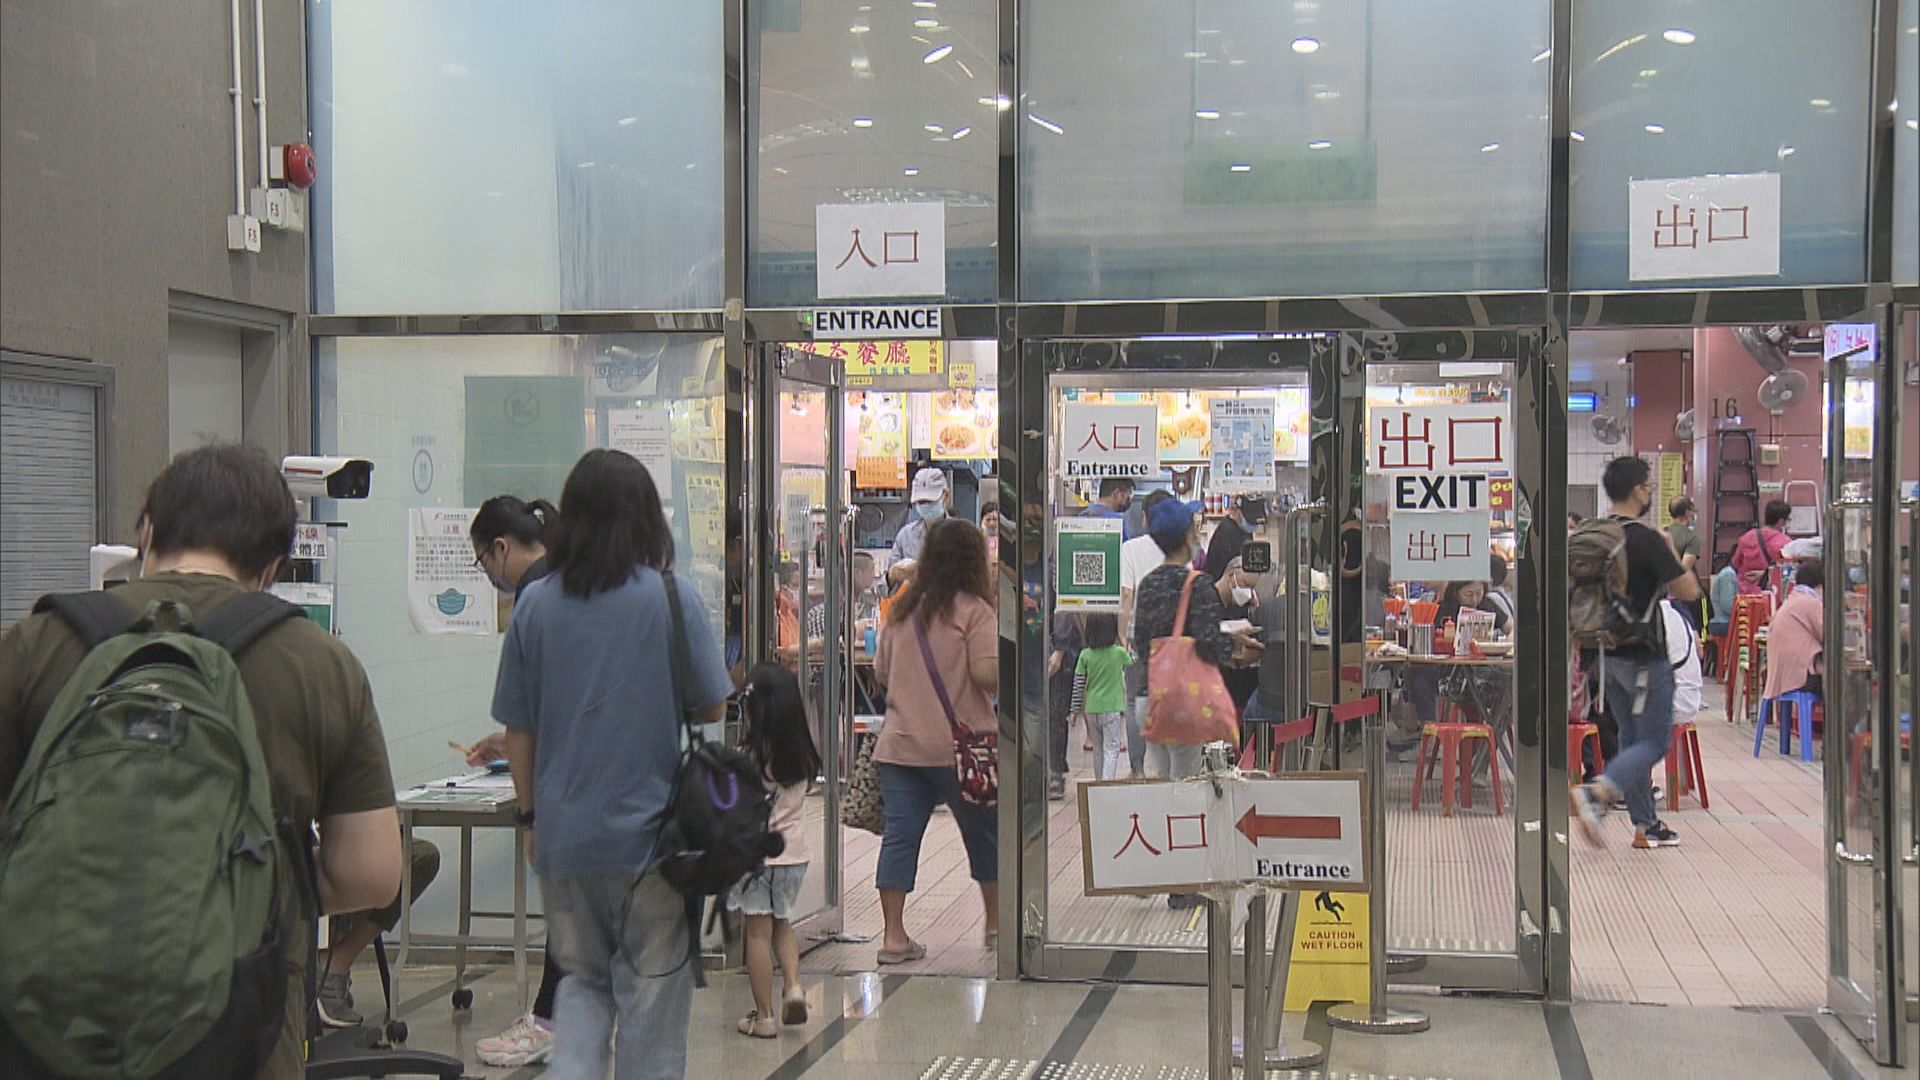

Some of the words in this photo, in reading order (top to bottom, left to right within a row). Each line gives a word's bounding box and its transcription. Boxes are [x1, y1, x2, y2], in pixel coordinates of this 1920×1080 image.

[1653, 203, 1749, 249] 出口
[835, 227, 919, 270] 入口
[815, 309, 939, 332] ENTRANCE
[1711, 397, 1738, 419] 16
[1077, 422, 1140, 452] 入口
[1379, 411, 1504, 471] 出口
[1066, 459, 1149, 476] Entrance
[1395, 474, 1487, 509] EXIT
[1407, 529, 1472, 562] 出口
[1112, 812, 1209, 859] 入口
[1255, 858, 1351, 879] Entrance
[1300, 940, 1324, 950] WET
[1326, 940, 1364, 950] FLOOR
[1308, 930, 1356, 940] CAUTION
